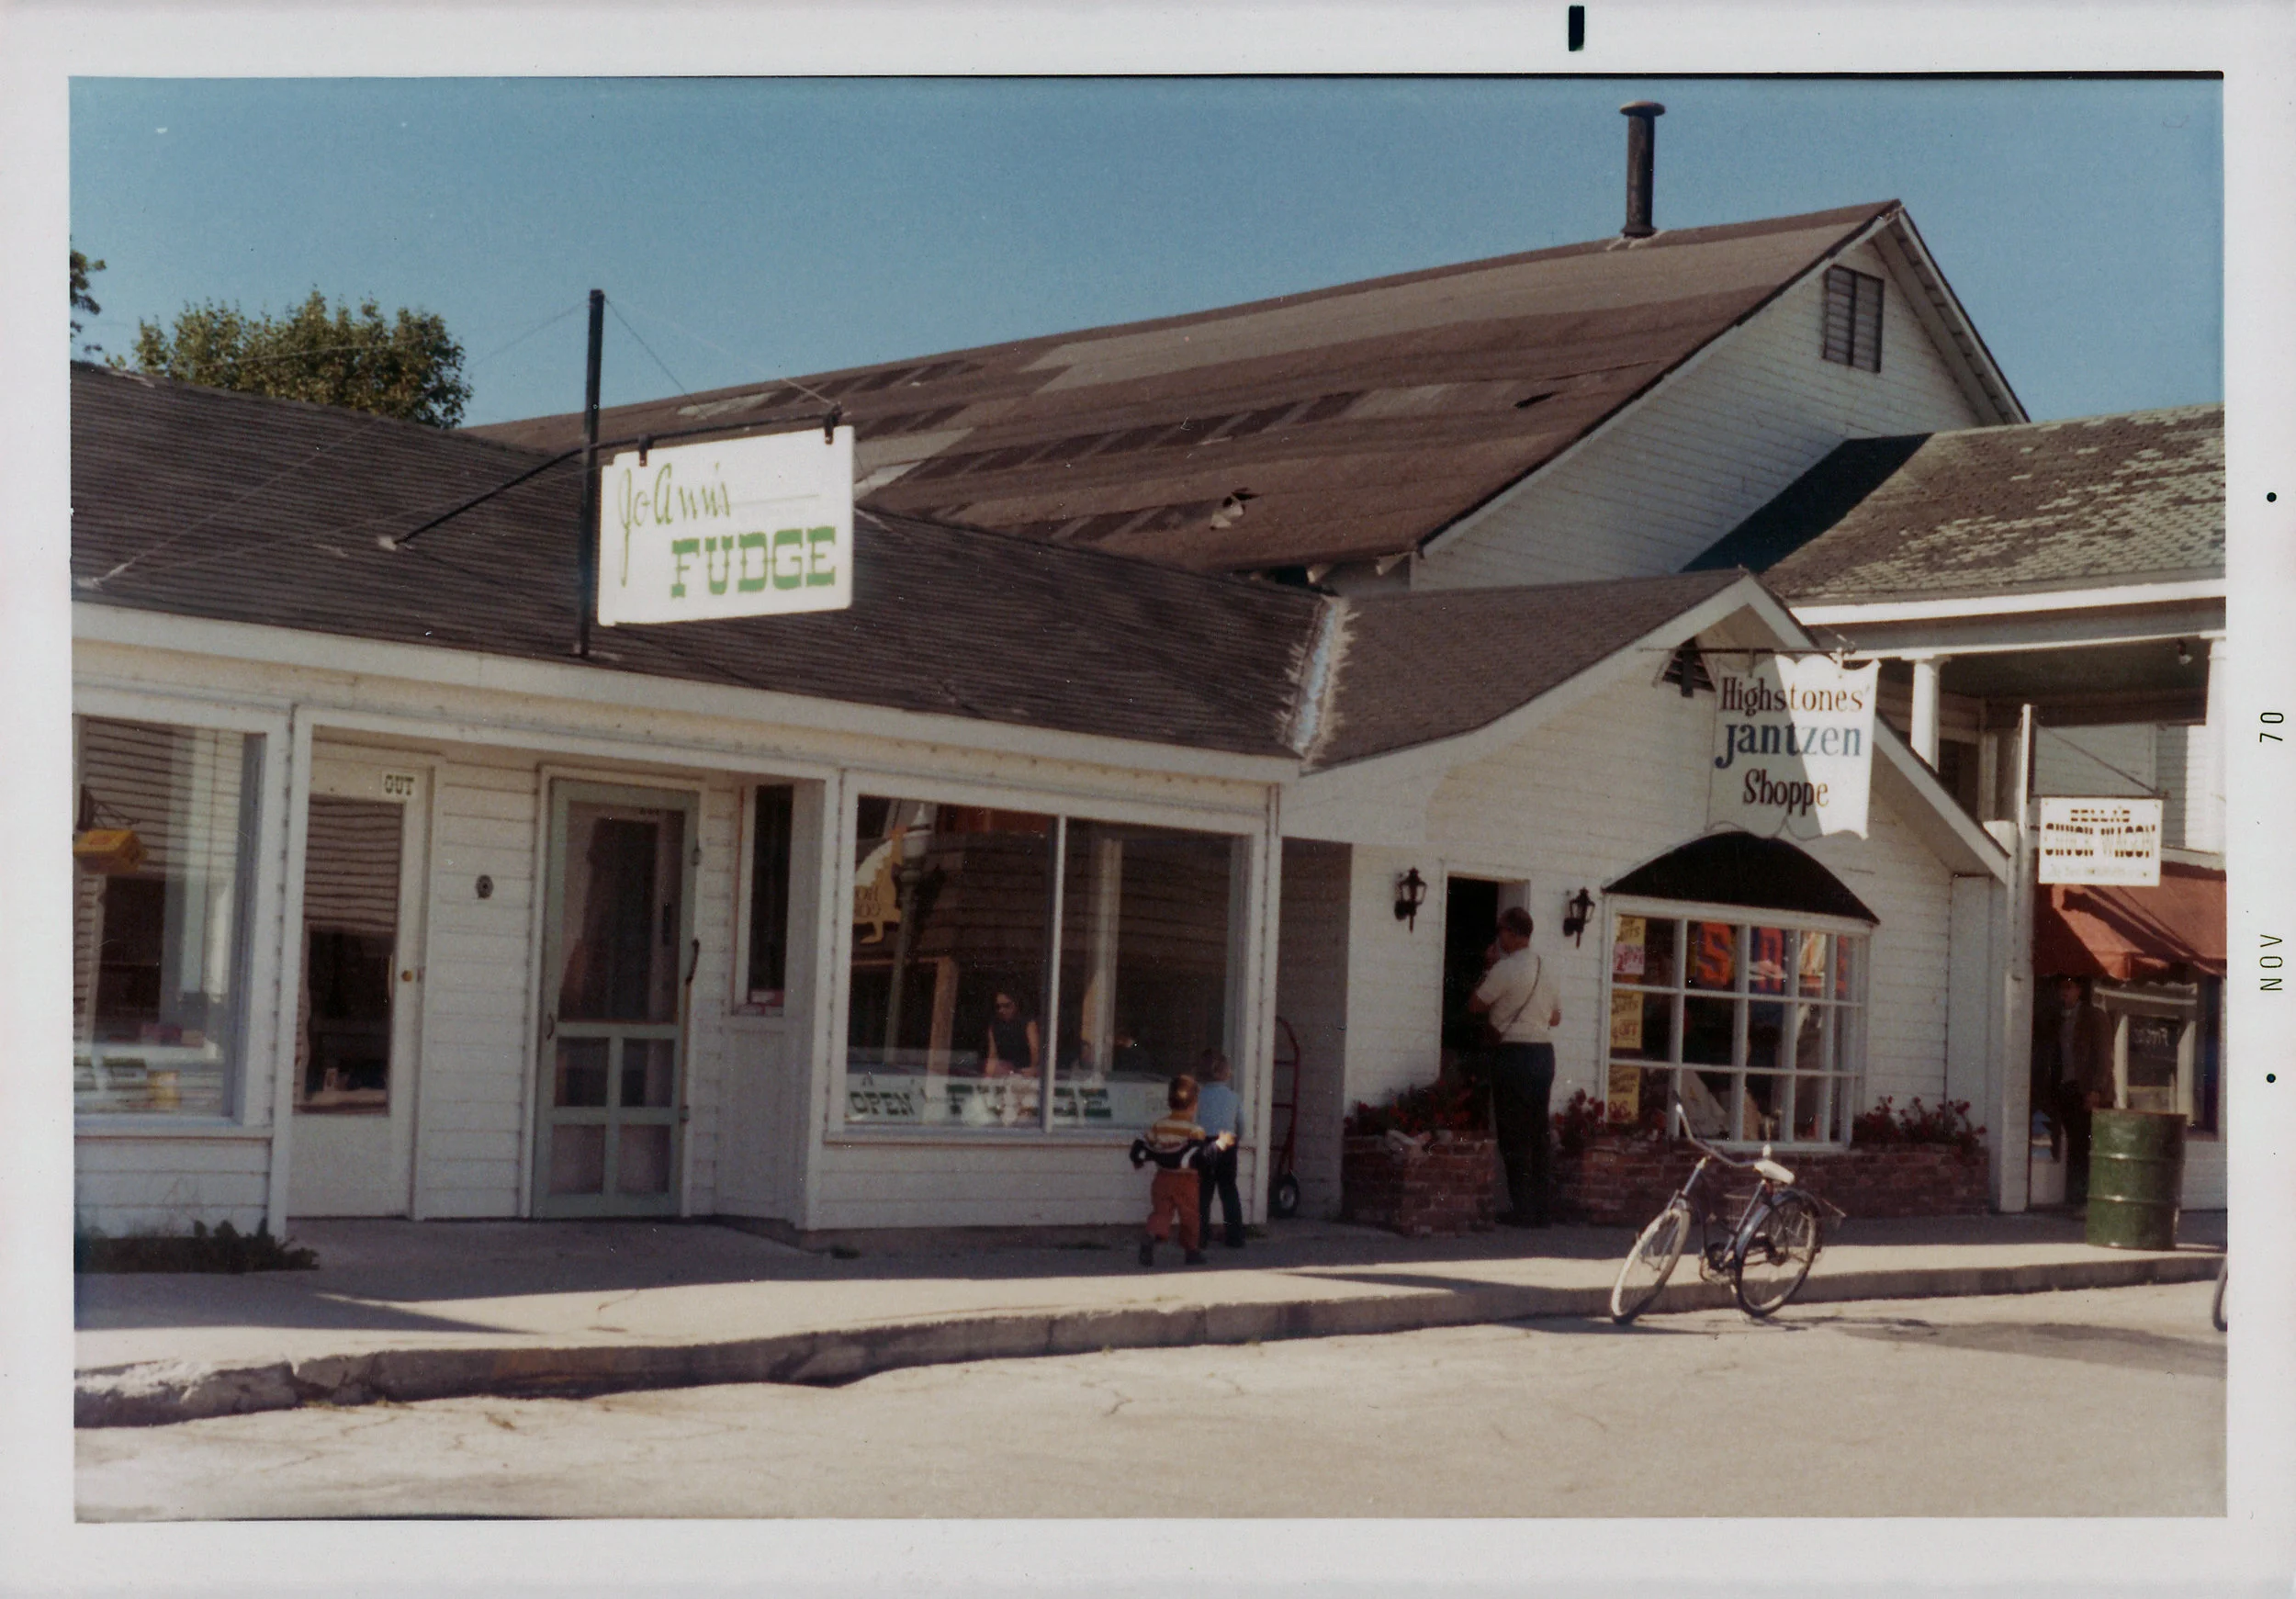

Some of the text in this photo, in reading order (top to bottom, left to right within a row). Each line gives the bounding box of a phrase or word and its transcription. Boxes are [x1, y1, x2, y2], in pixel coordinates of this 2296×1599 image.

[670, 525, 837, 600] FUDGE
[384, 773, 415, 796] OUT
[1741, 768, 1829, 817] Shoppe
[849, 1090, 916, 1116] OPEN
